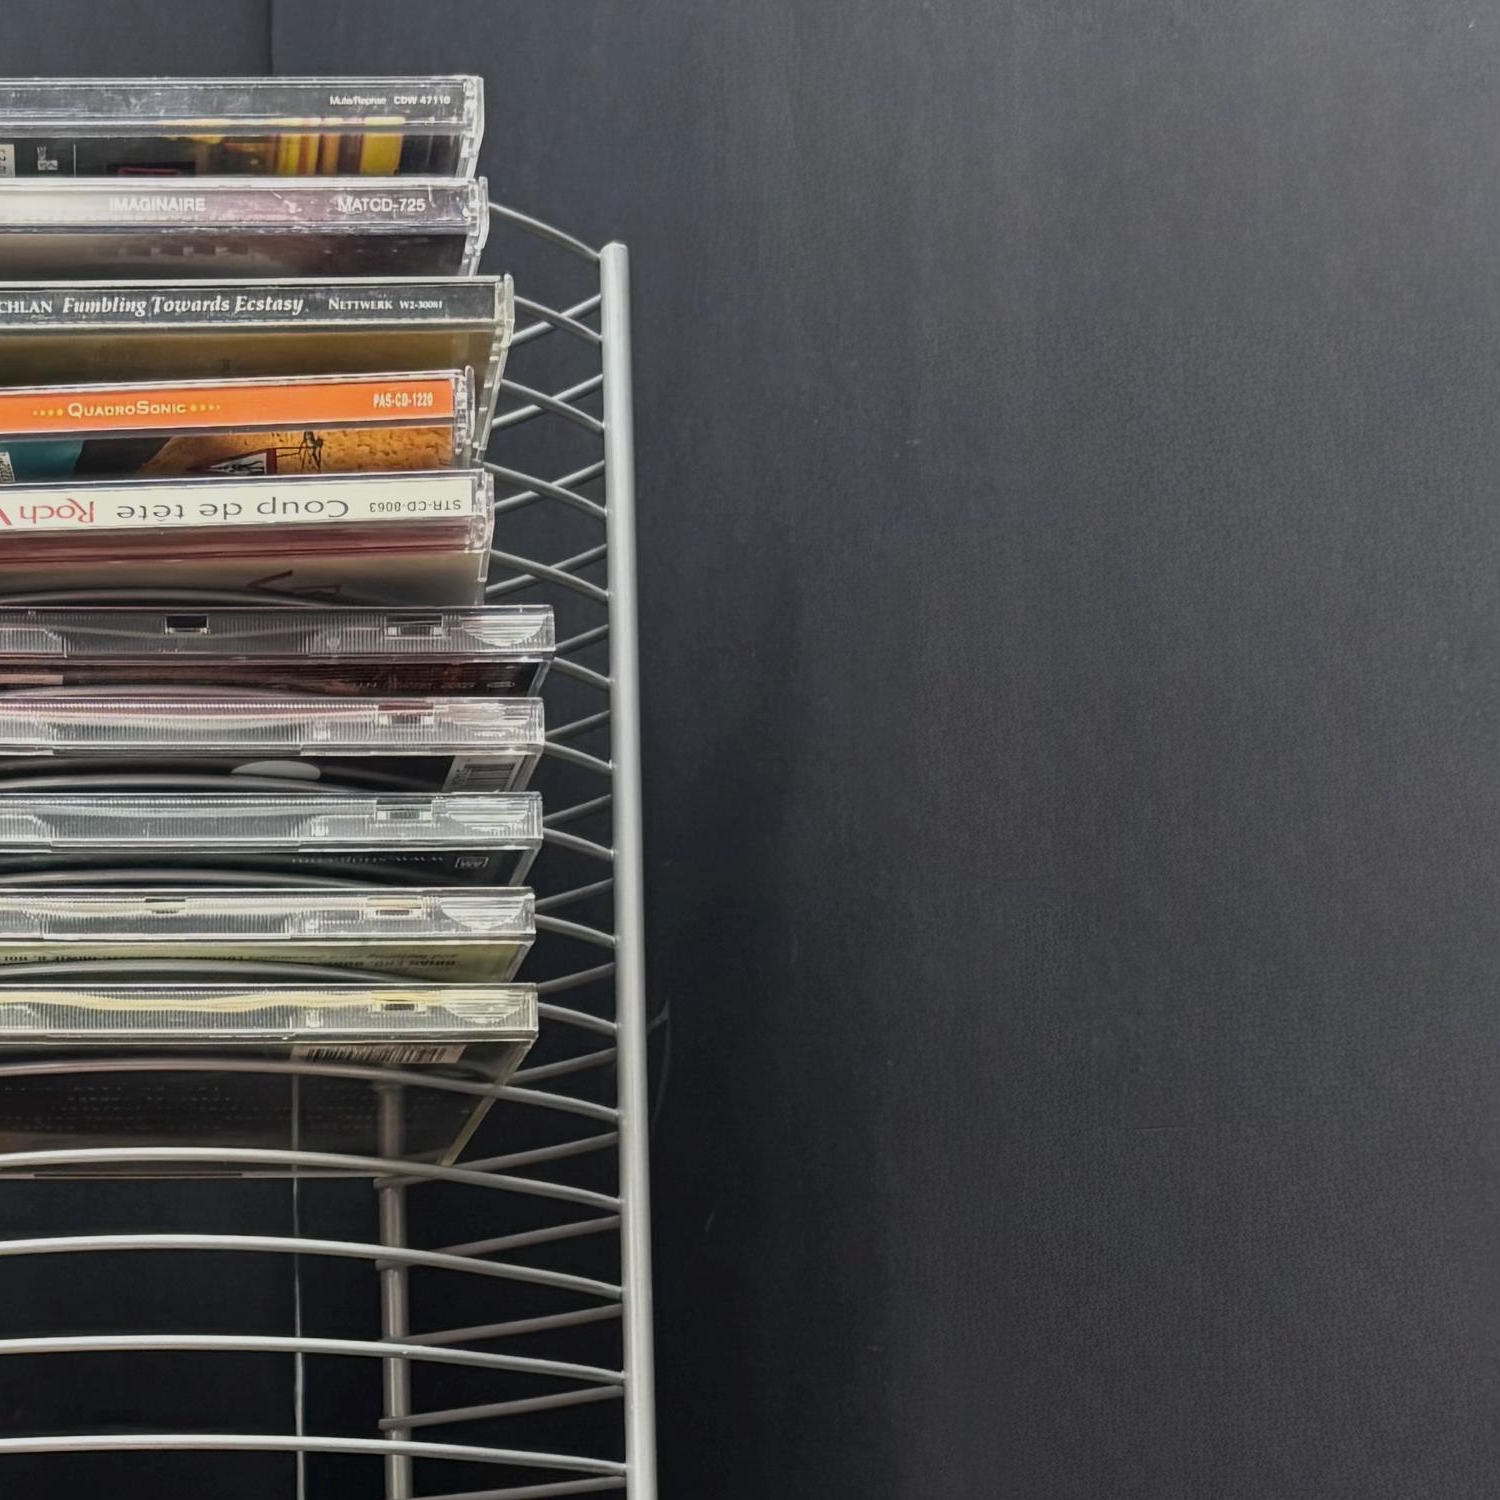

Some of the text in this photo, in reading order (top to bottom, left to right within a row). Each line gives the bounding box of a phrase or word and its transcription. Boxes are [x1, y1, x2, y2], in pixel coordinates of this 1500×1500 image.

[109, 197, 206, 212] IMAGINAIRE
[337, 197, 426, 212] MATCD-725
[62, 296, 304, 317] Fumbling Towards Ecstasy
[372, 392, 434, 408] PAS-CD-1220
[19, 498, 95, 525] Roch
[117, 497, 349, 522] Coup de tête
